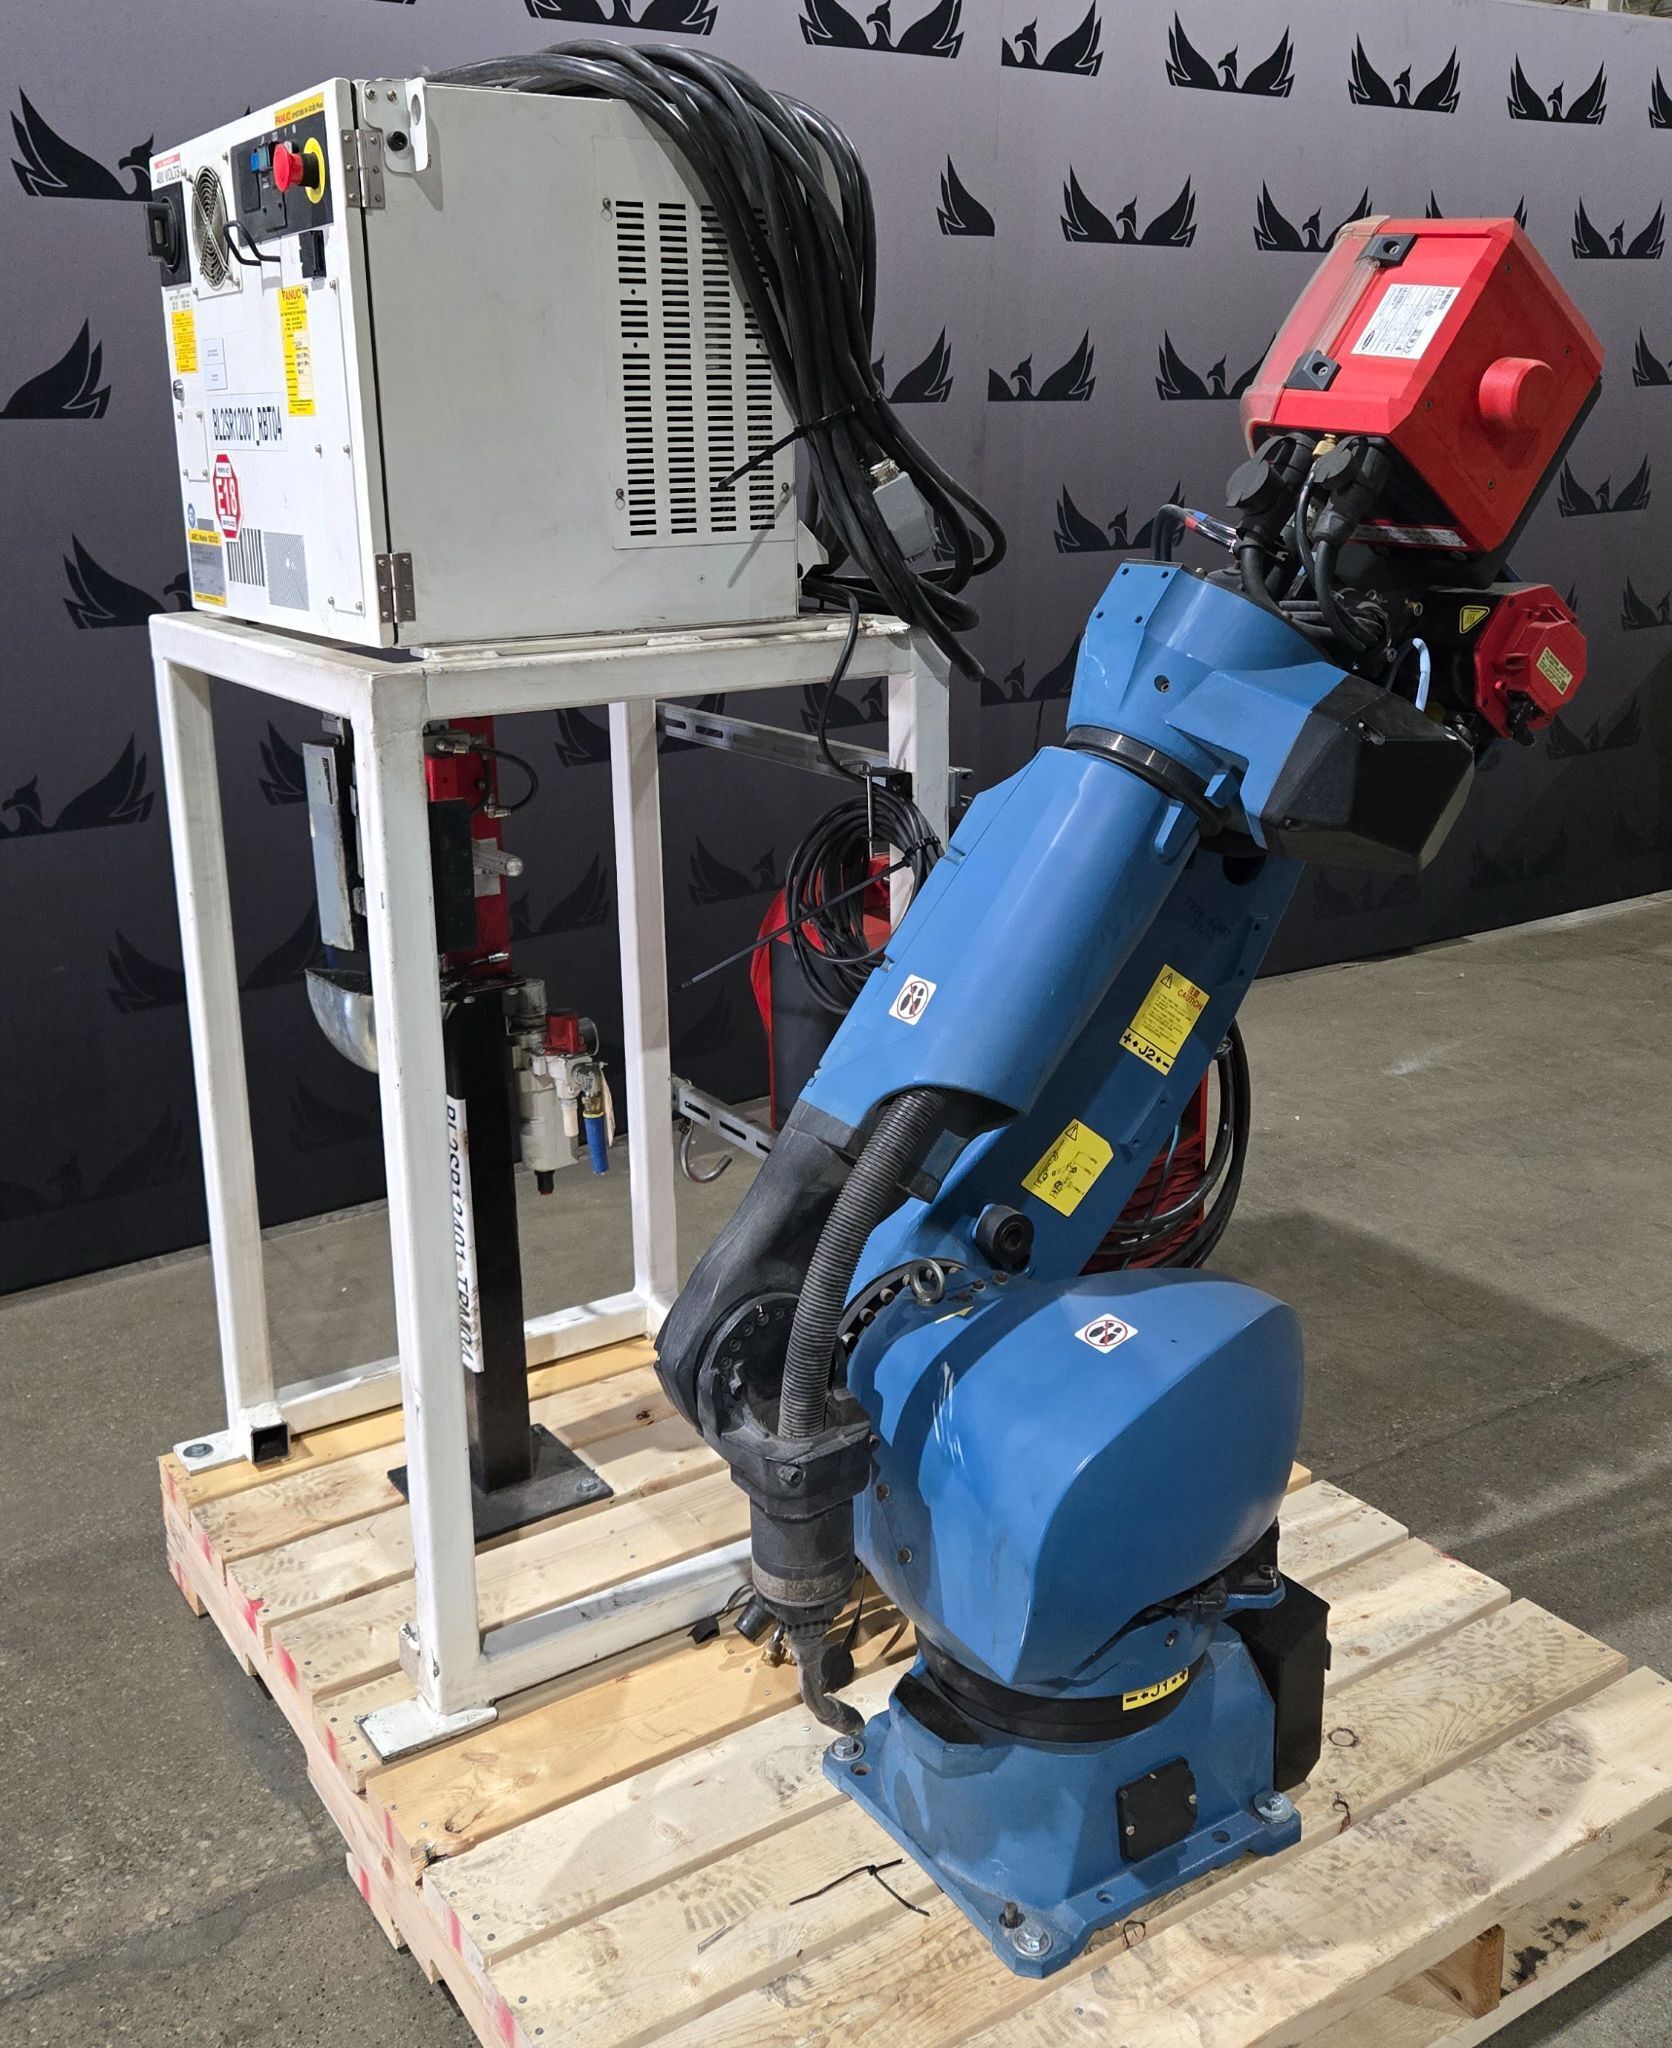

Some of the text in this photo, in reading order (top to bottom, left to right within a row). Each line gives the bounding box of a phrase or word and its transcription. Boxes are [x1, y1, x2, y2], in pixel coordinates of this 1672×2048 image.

[275, 111, 291, 126] FANUC
[281, 288, 301, 301] FANUC
[215, 478, 238, 516] E18
[1177, 989, 1203, 1012] CAUTION
[1138, 1046, 1156, 1062] J2
[1150, 1681, 1168, 1697] J1
